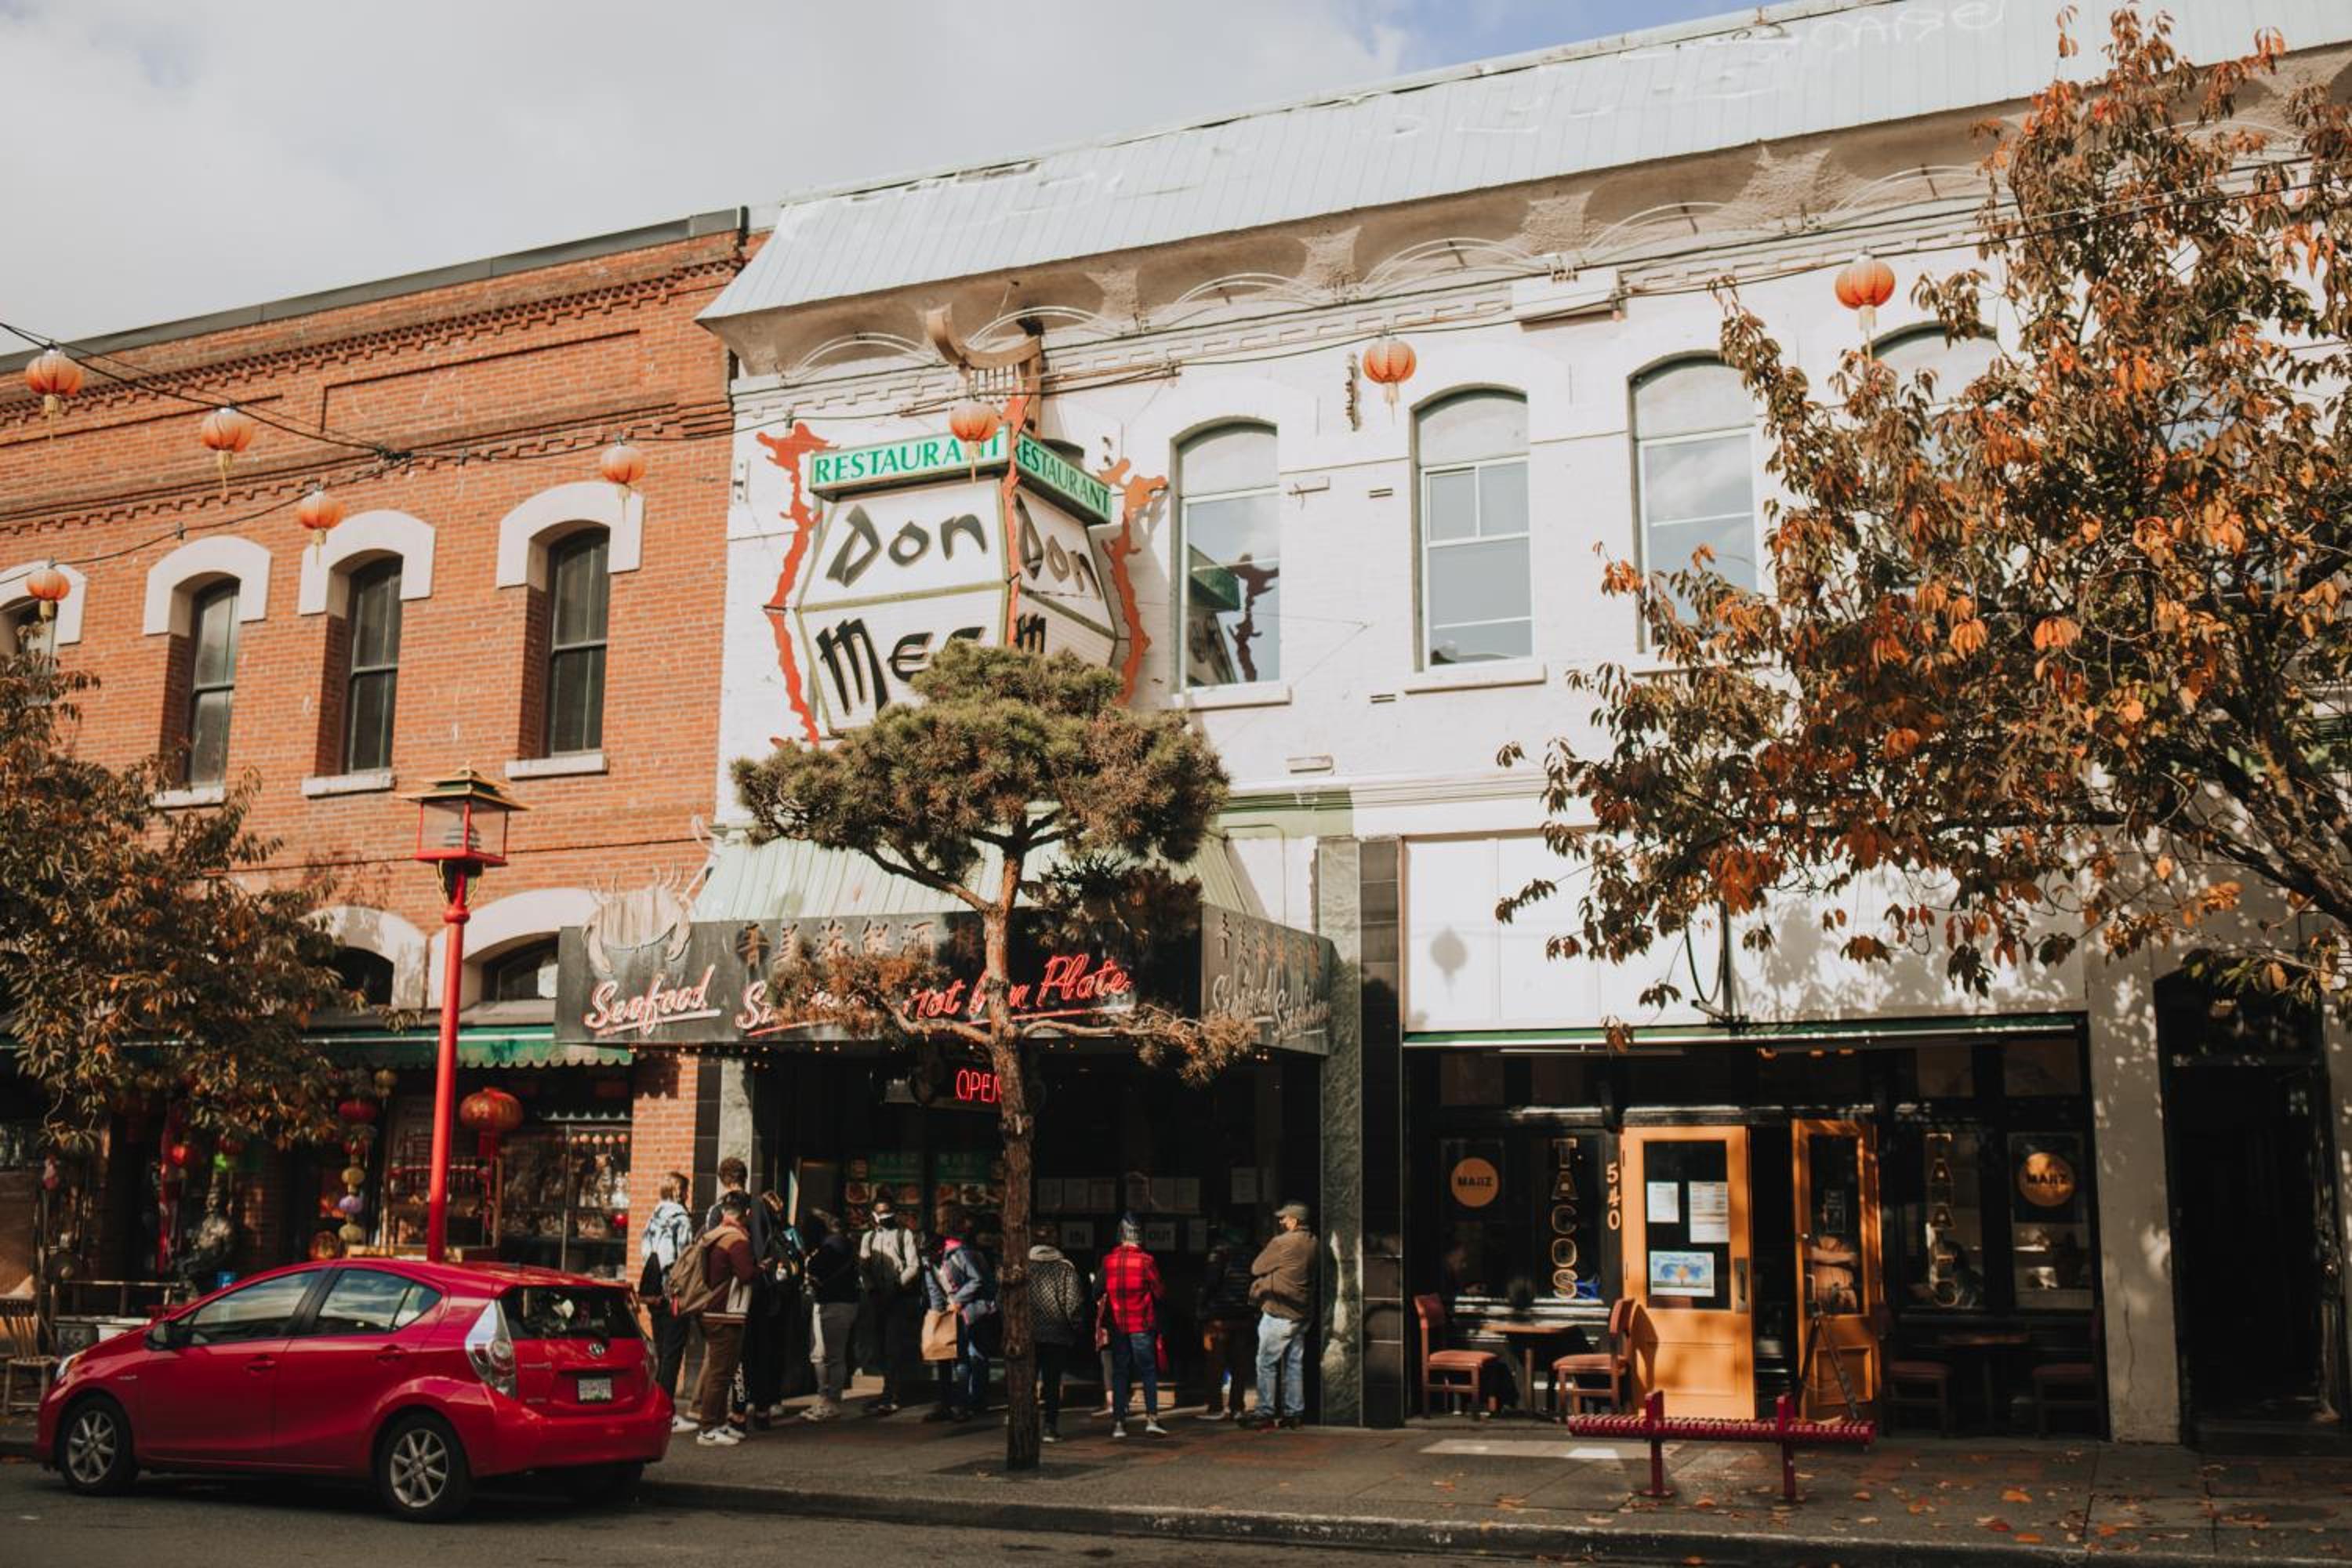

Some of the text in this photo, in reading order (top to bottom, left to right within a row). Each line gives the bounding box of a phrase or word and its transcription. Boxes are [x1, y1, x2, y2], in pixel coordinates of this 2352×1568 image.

[815, 617, 985, 717] Me
[584, 964, 717, 1035] Seafood
[1036, 953, 1131, 1007] Plate
[1551, 1138, 1580, 1299] TACOS
[1606, 1162, 1621, 1230] 540
